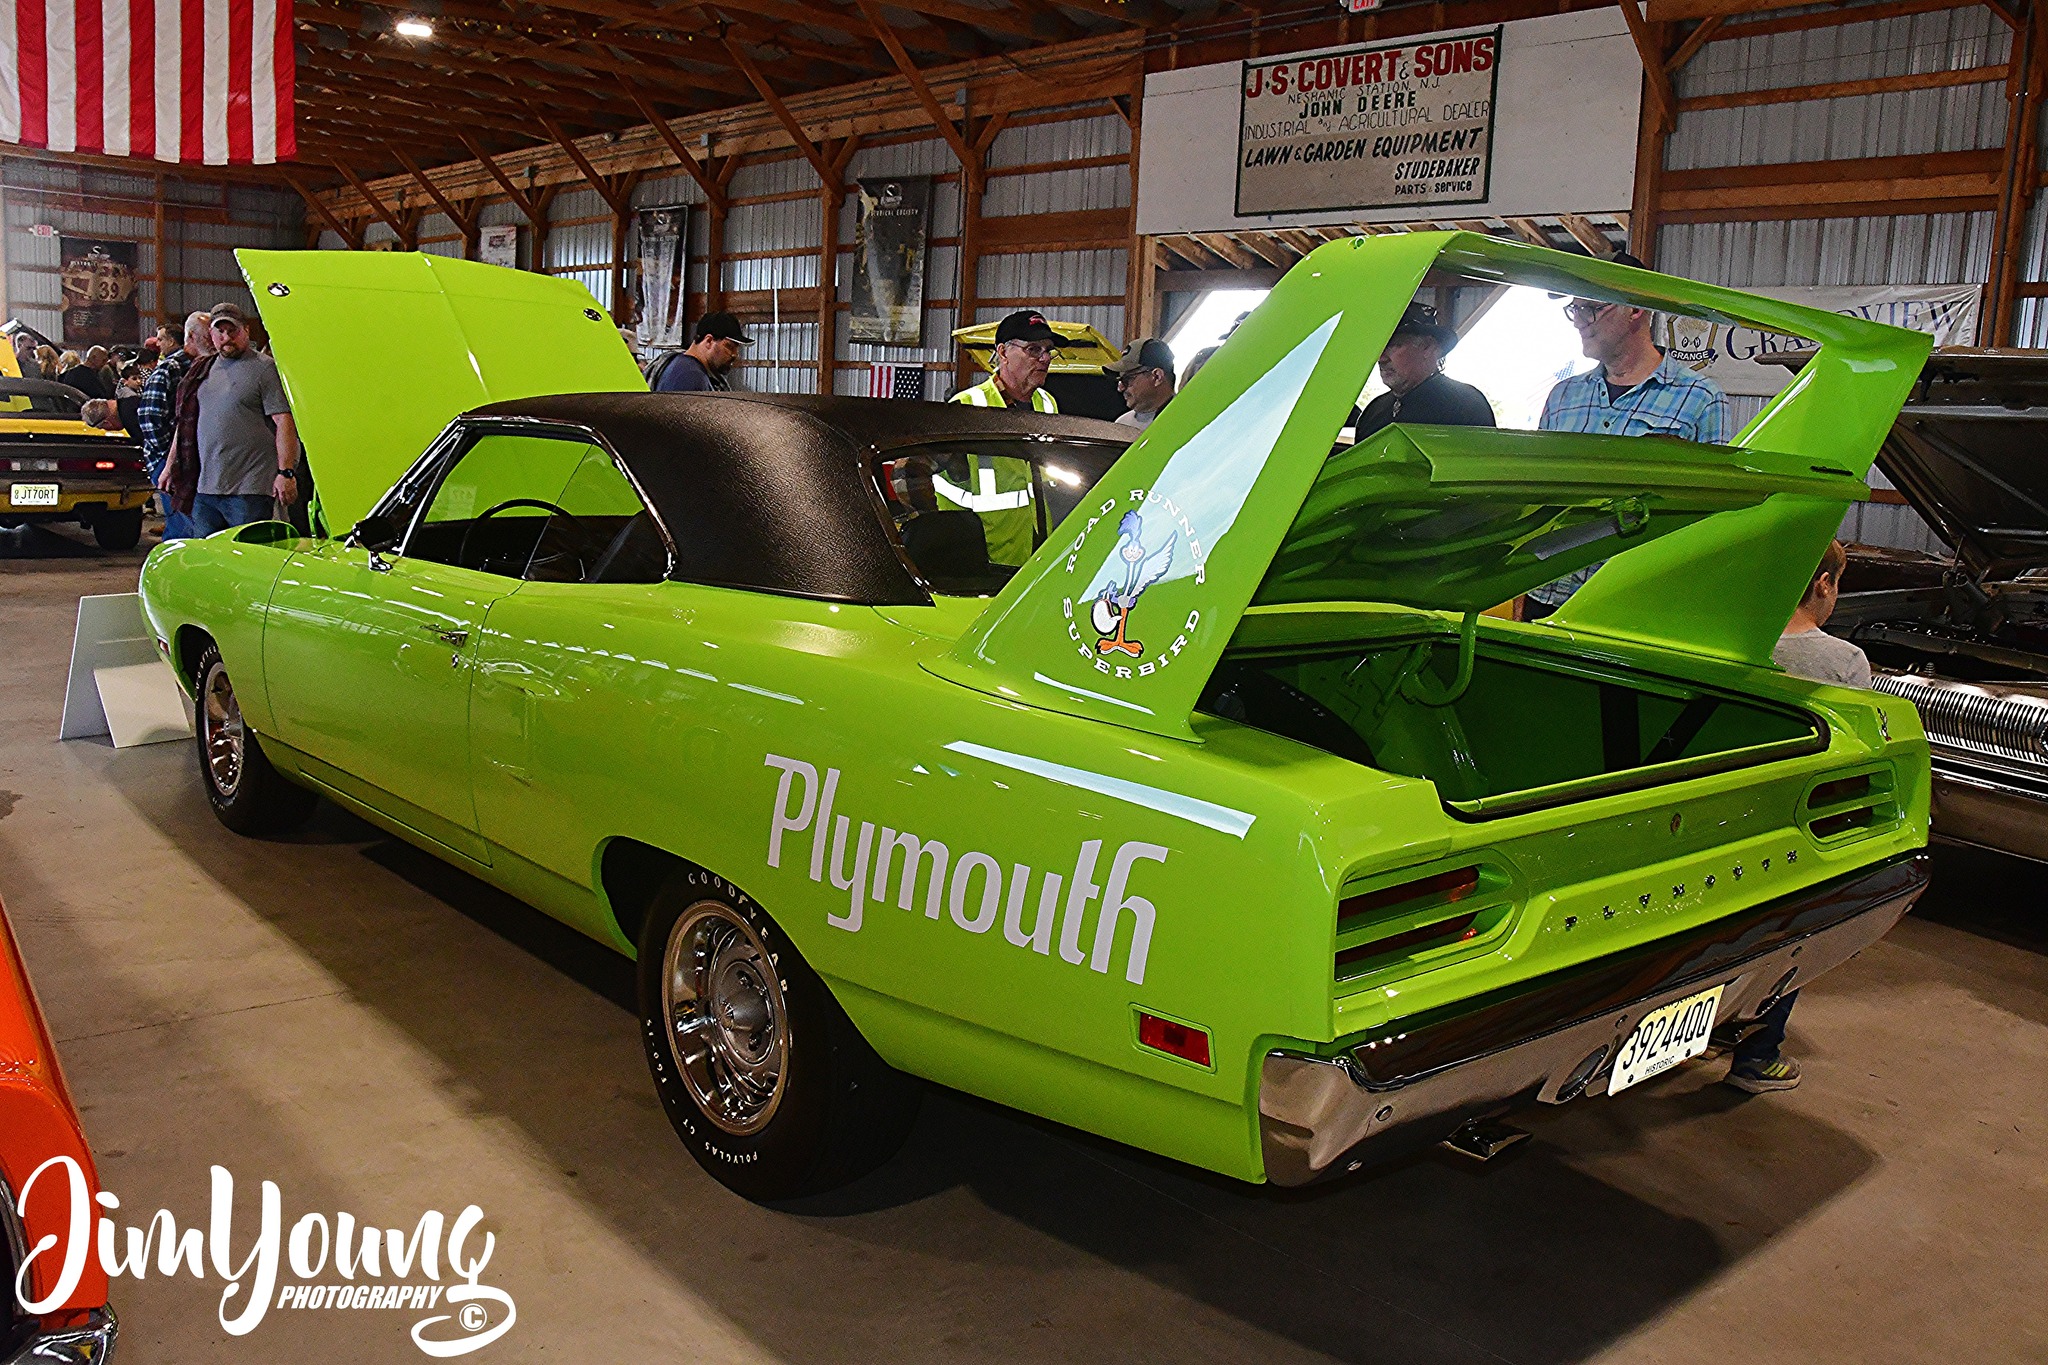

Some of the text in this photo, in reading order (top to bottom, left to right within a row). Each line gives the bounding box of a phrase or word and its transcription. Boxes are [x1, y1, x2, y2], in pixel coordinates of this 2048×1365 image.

[1399, 61, 1410, 80] &
[1413, 37, 1494, 78] SONS
[1288, 87, 1346, 105] NESHANIC
[1299, 91, 1416, 119] JOHN DEERE
[1244, 121, 1311, 140] INDUSTRIAL
[1443, 100, 1490, 121] DEALER
[1245, 144, 1293, 168] LAWN
[1303, 139, 1367, 163] GARDEN
[1372, 127, 1484, 159] EQUIPMENT
[1394, 157, 1481, 181] STUDEBAKER
[1394, 183, 1426, 195] PARTS
[1434, 180, 1473, 193] service
[99, 281, 119, 300] 39
[1670, 350, 1710, 361] GRANGE
[1065, 489, 1206, 586] ROAD RUNNER
[1063, 597, 1200, 679] SUPERBIRD
[764, 753, 1169, 986] Plymouth
[688, 871, 788, 992] GOODYEAR
[1644, 1055, 1675, 1075] HISTORIC
[705, 1141, 758, 1164] POLYGLAS
